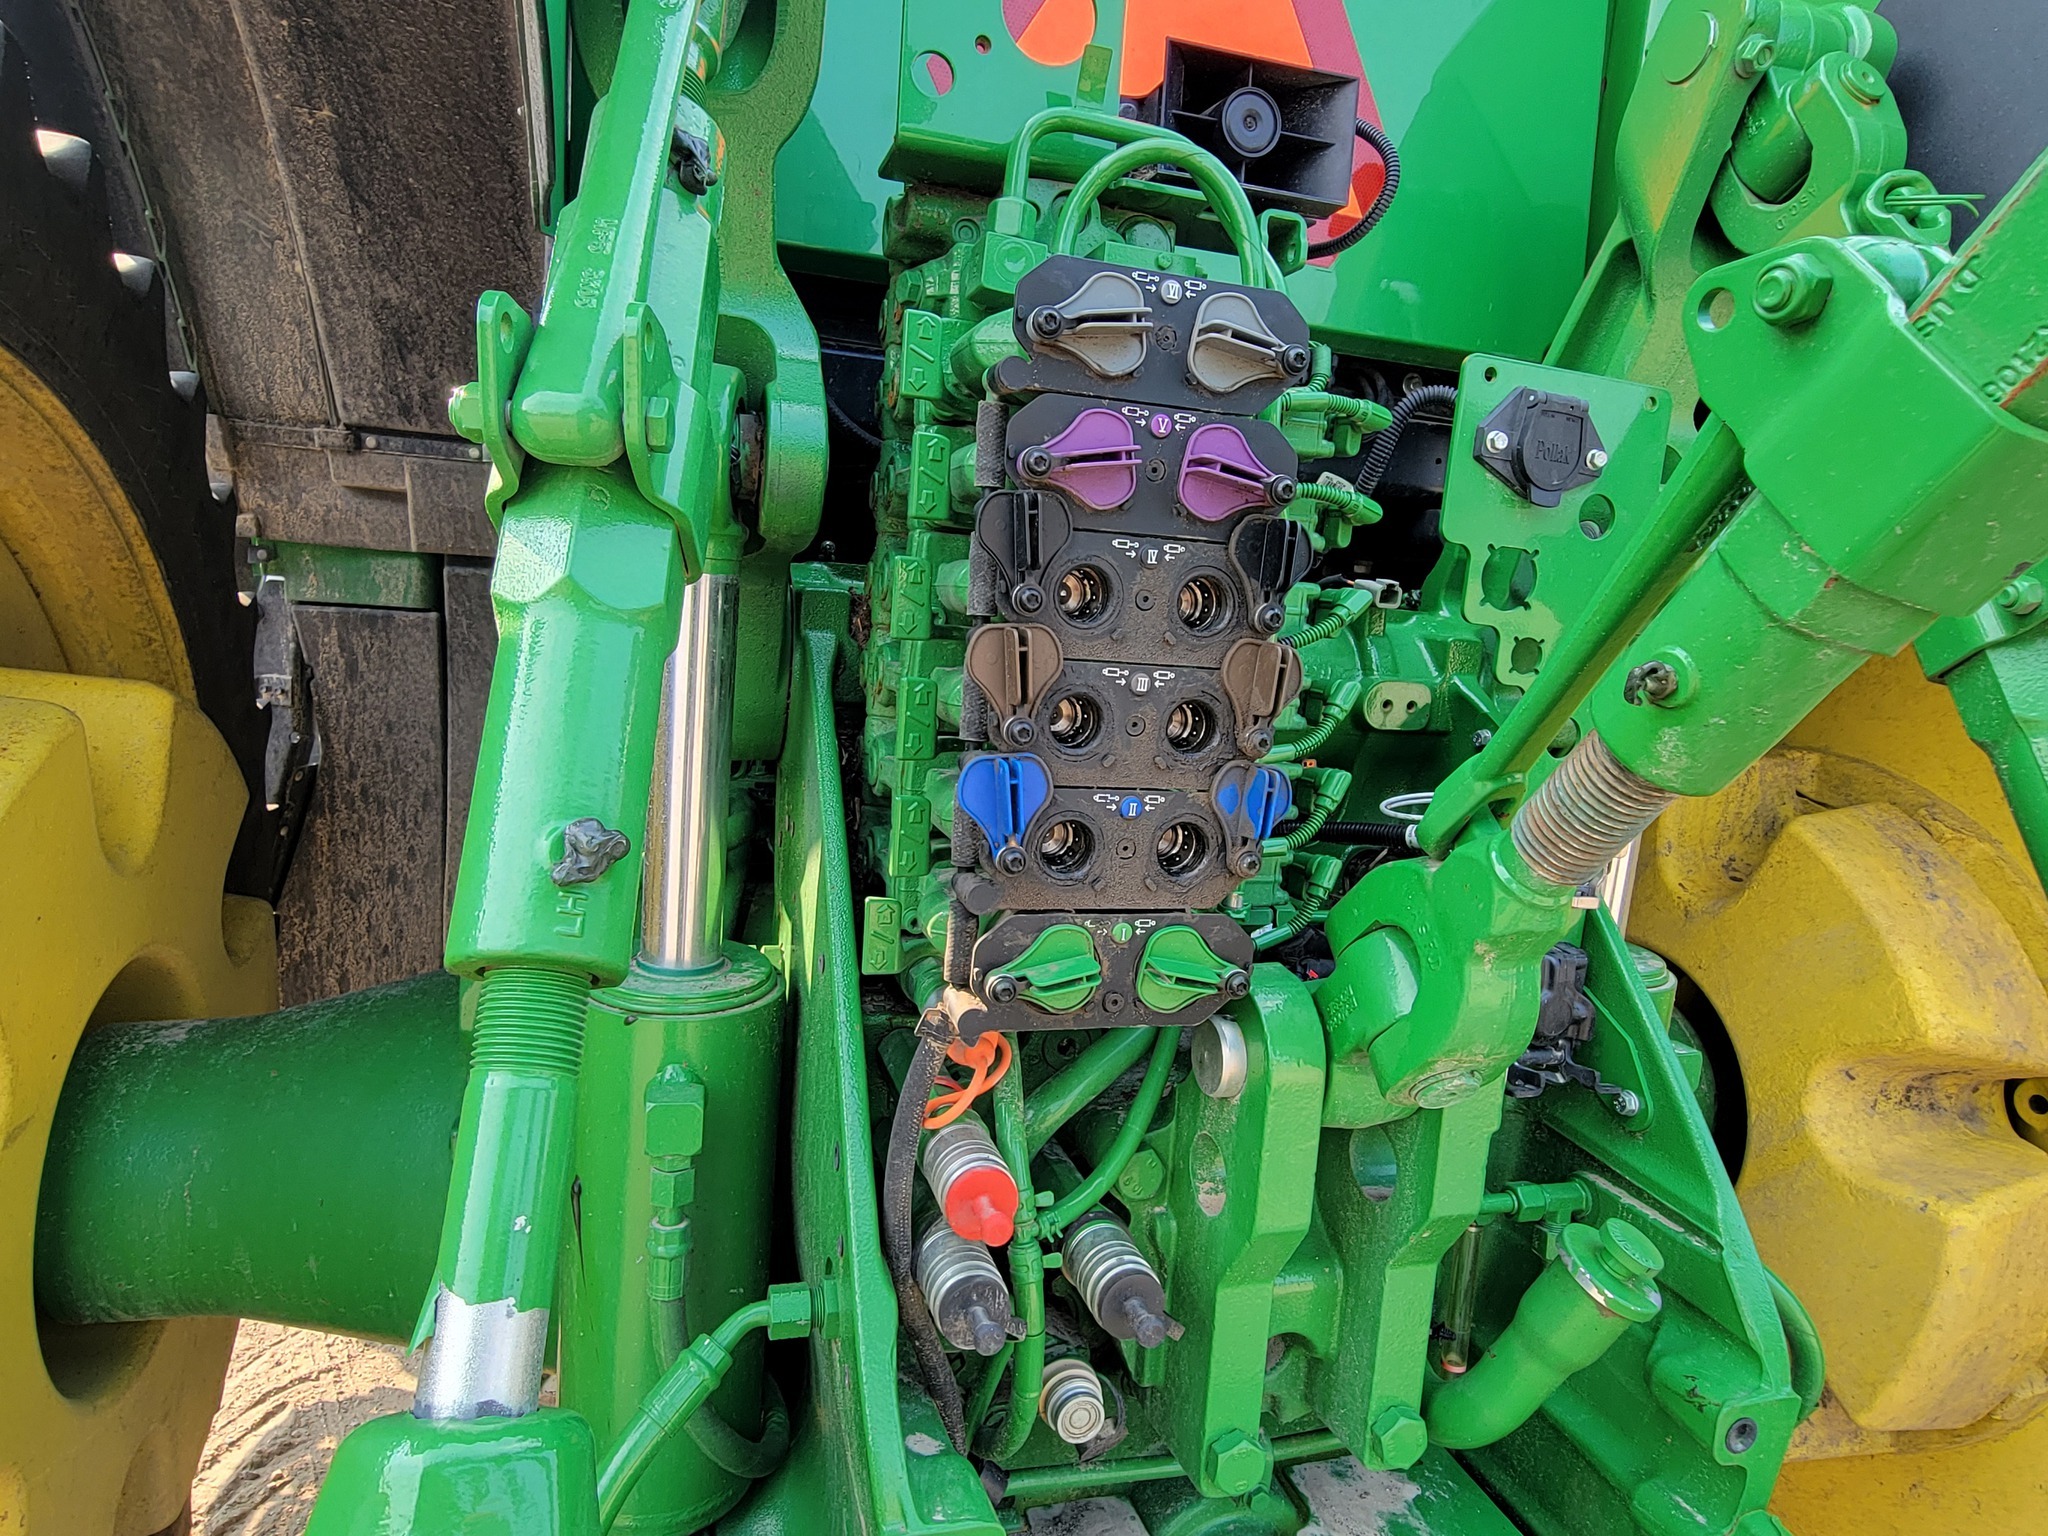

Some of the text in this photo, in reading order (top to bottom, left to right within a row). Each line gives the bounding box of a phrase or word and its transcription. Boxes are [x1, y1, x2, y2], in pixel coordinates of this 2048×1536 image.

[1167, 283, 1180, 299] VI
[1158, 417, 1169, 433] V
[1534, 440, 1573, 465] Pollak
[1147, 549, 1159, 565] IV
[1136, 677, 1150, 692] III
[1128, 803, 1137, 817] II
[554, 890, 590, 939] LH
